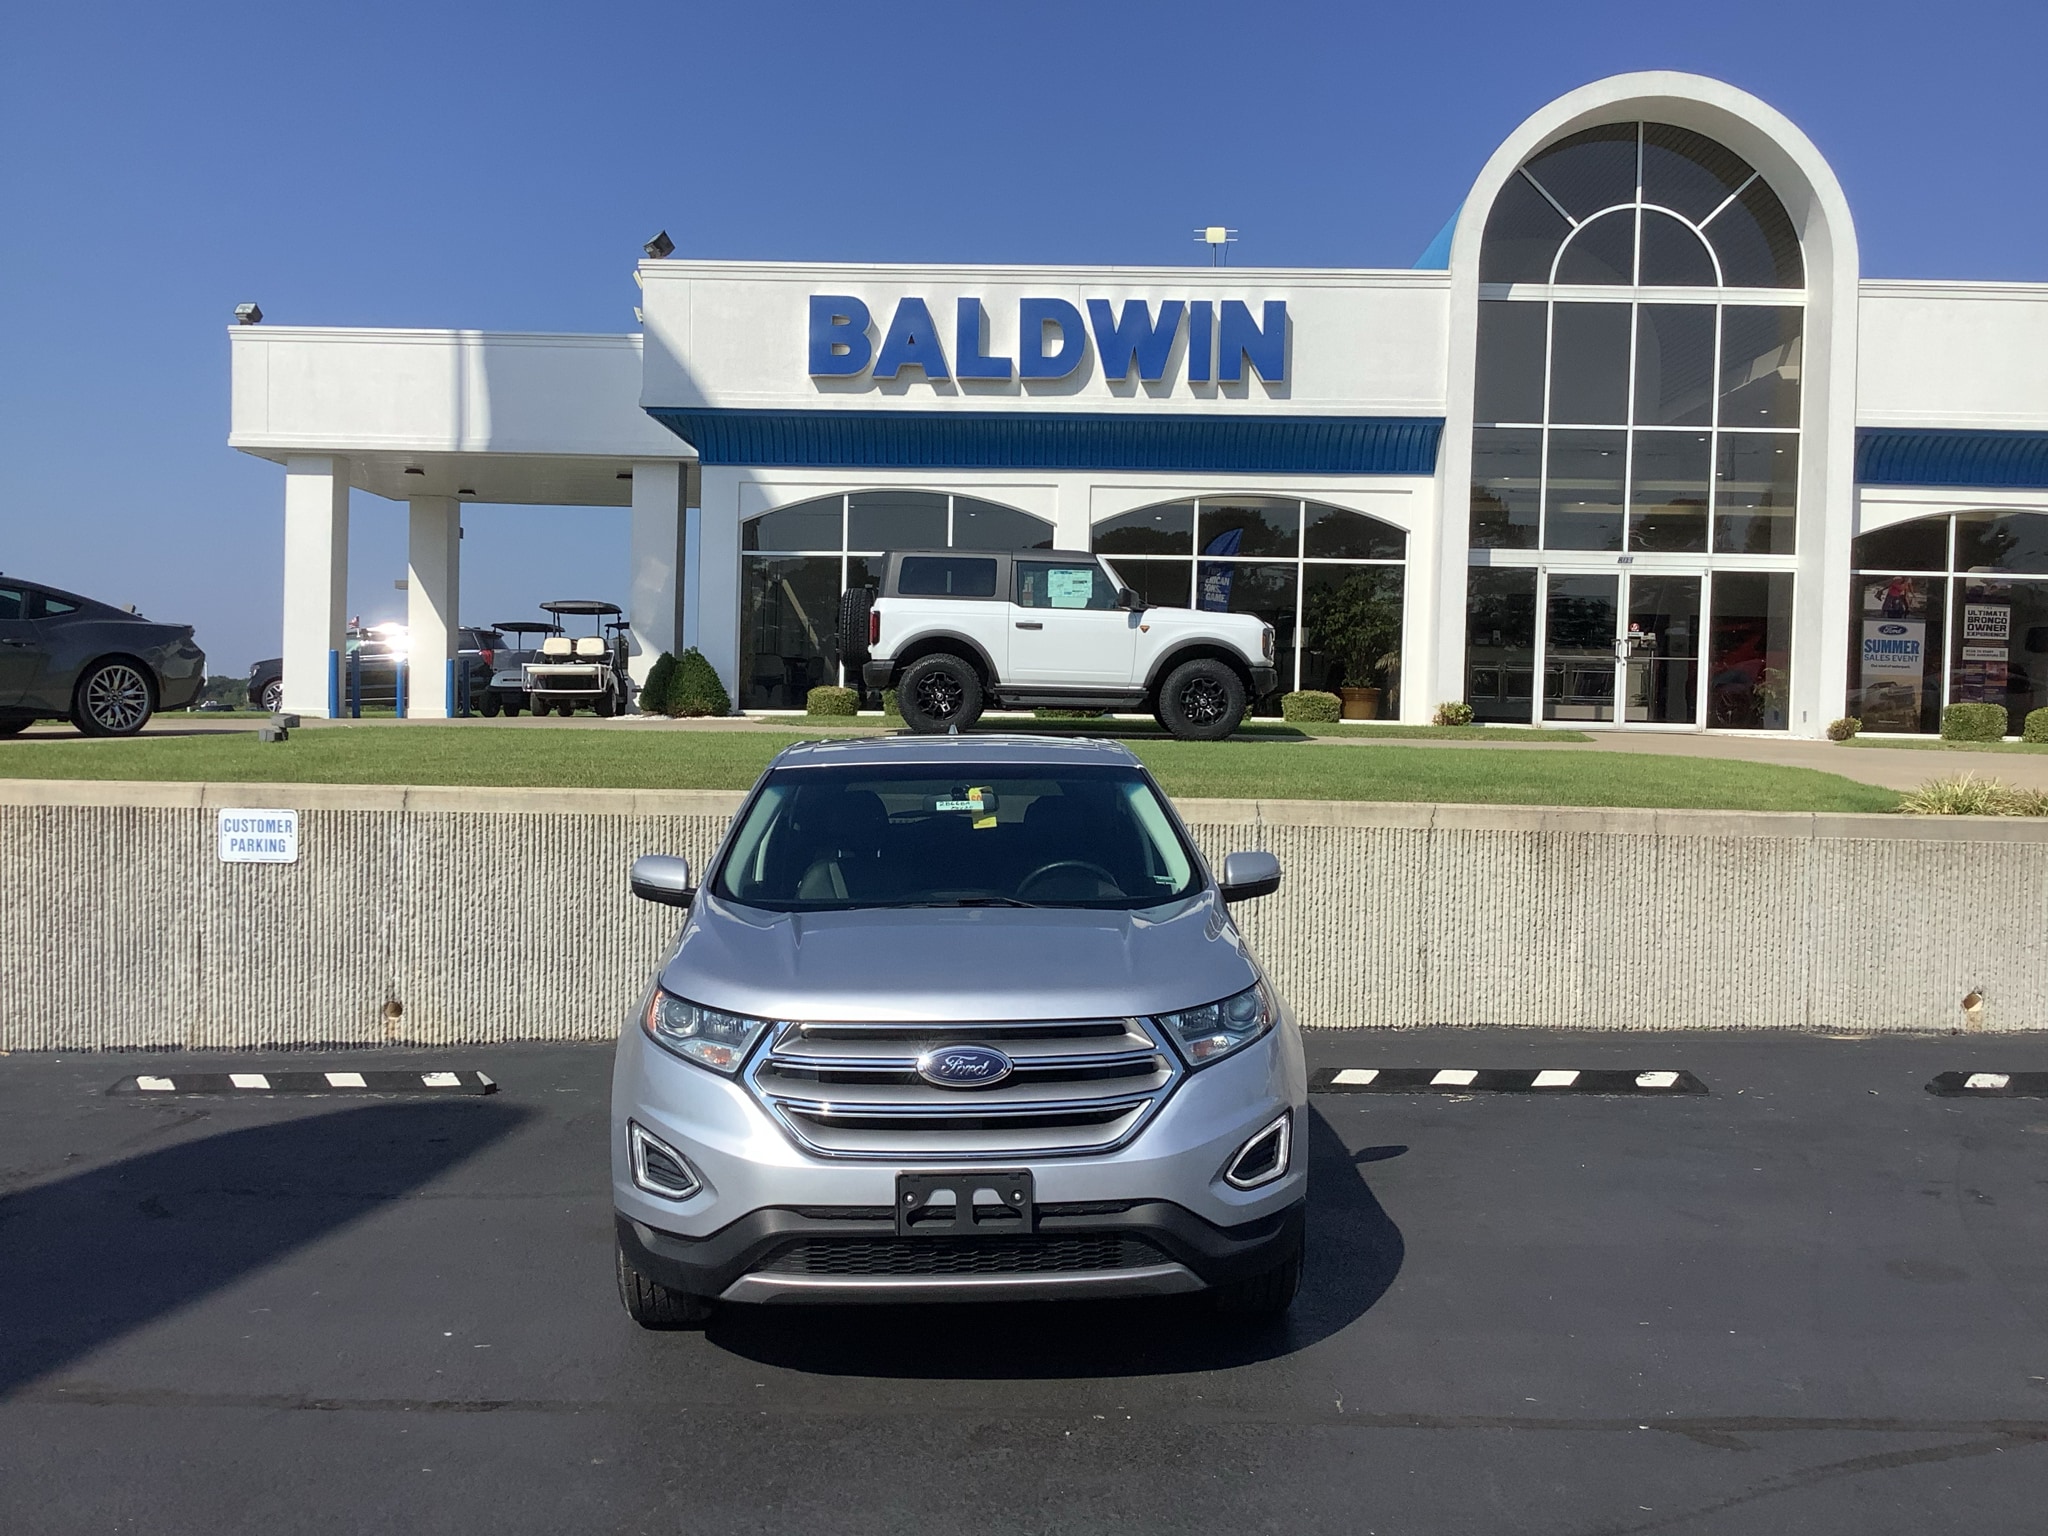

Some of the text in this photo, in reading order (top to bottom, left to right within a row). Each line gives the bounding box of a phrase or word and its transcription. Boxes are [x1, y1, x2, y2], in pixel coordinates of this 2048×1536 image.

[809, 295, 1286, 383] BALDWIN
[1967, 609, 2008, 617] ULTIMATE
[1967, 616, 2007, 624] BRONCO
[1967, 624, 2007, 632] OWNER
[1864, 639, 1920, 655] SUMMER
[1864, 653, 1890, 662] SALES
[224, 818, 292, 833] CUSTOMER
[230, 838, 286, 852] PARKING
[941, 1055, 990, 1075] Ford
